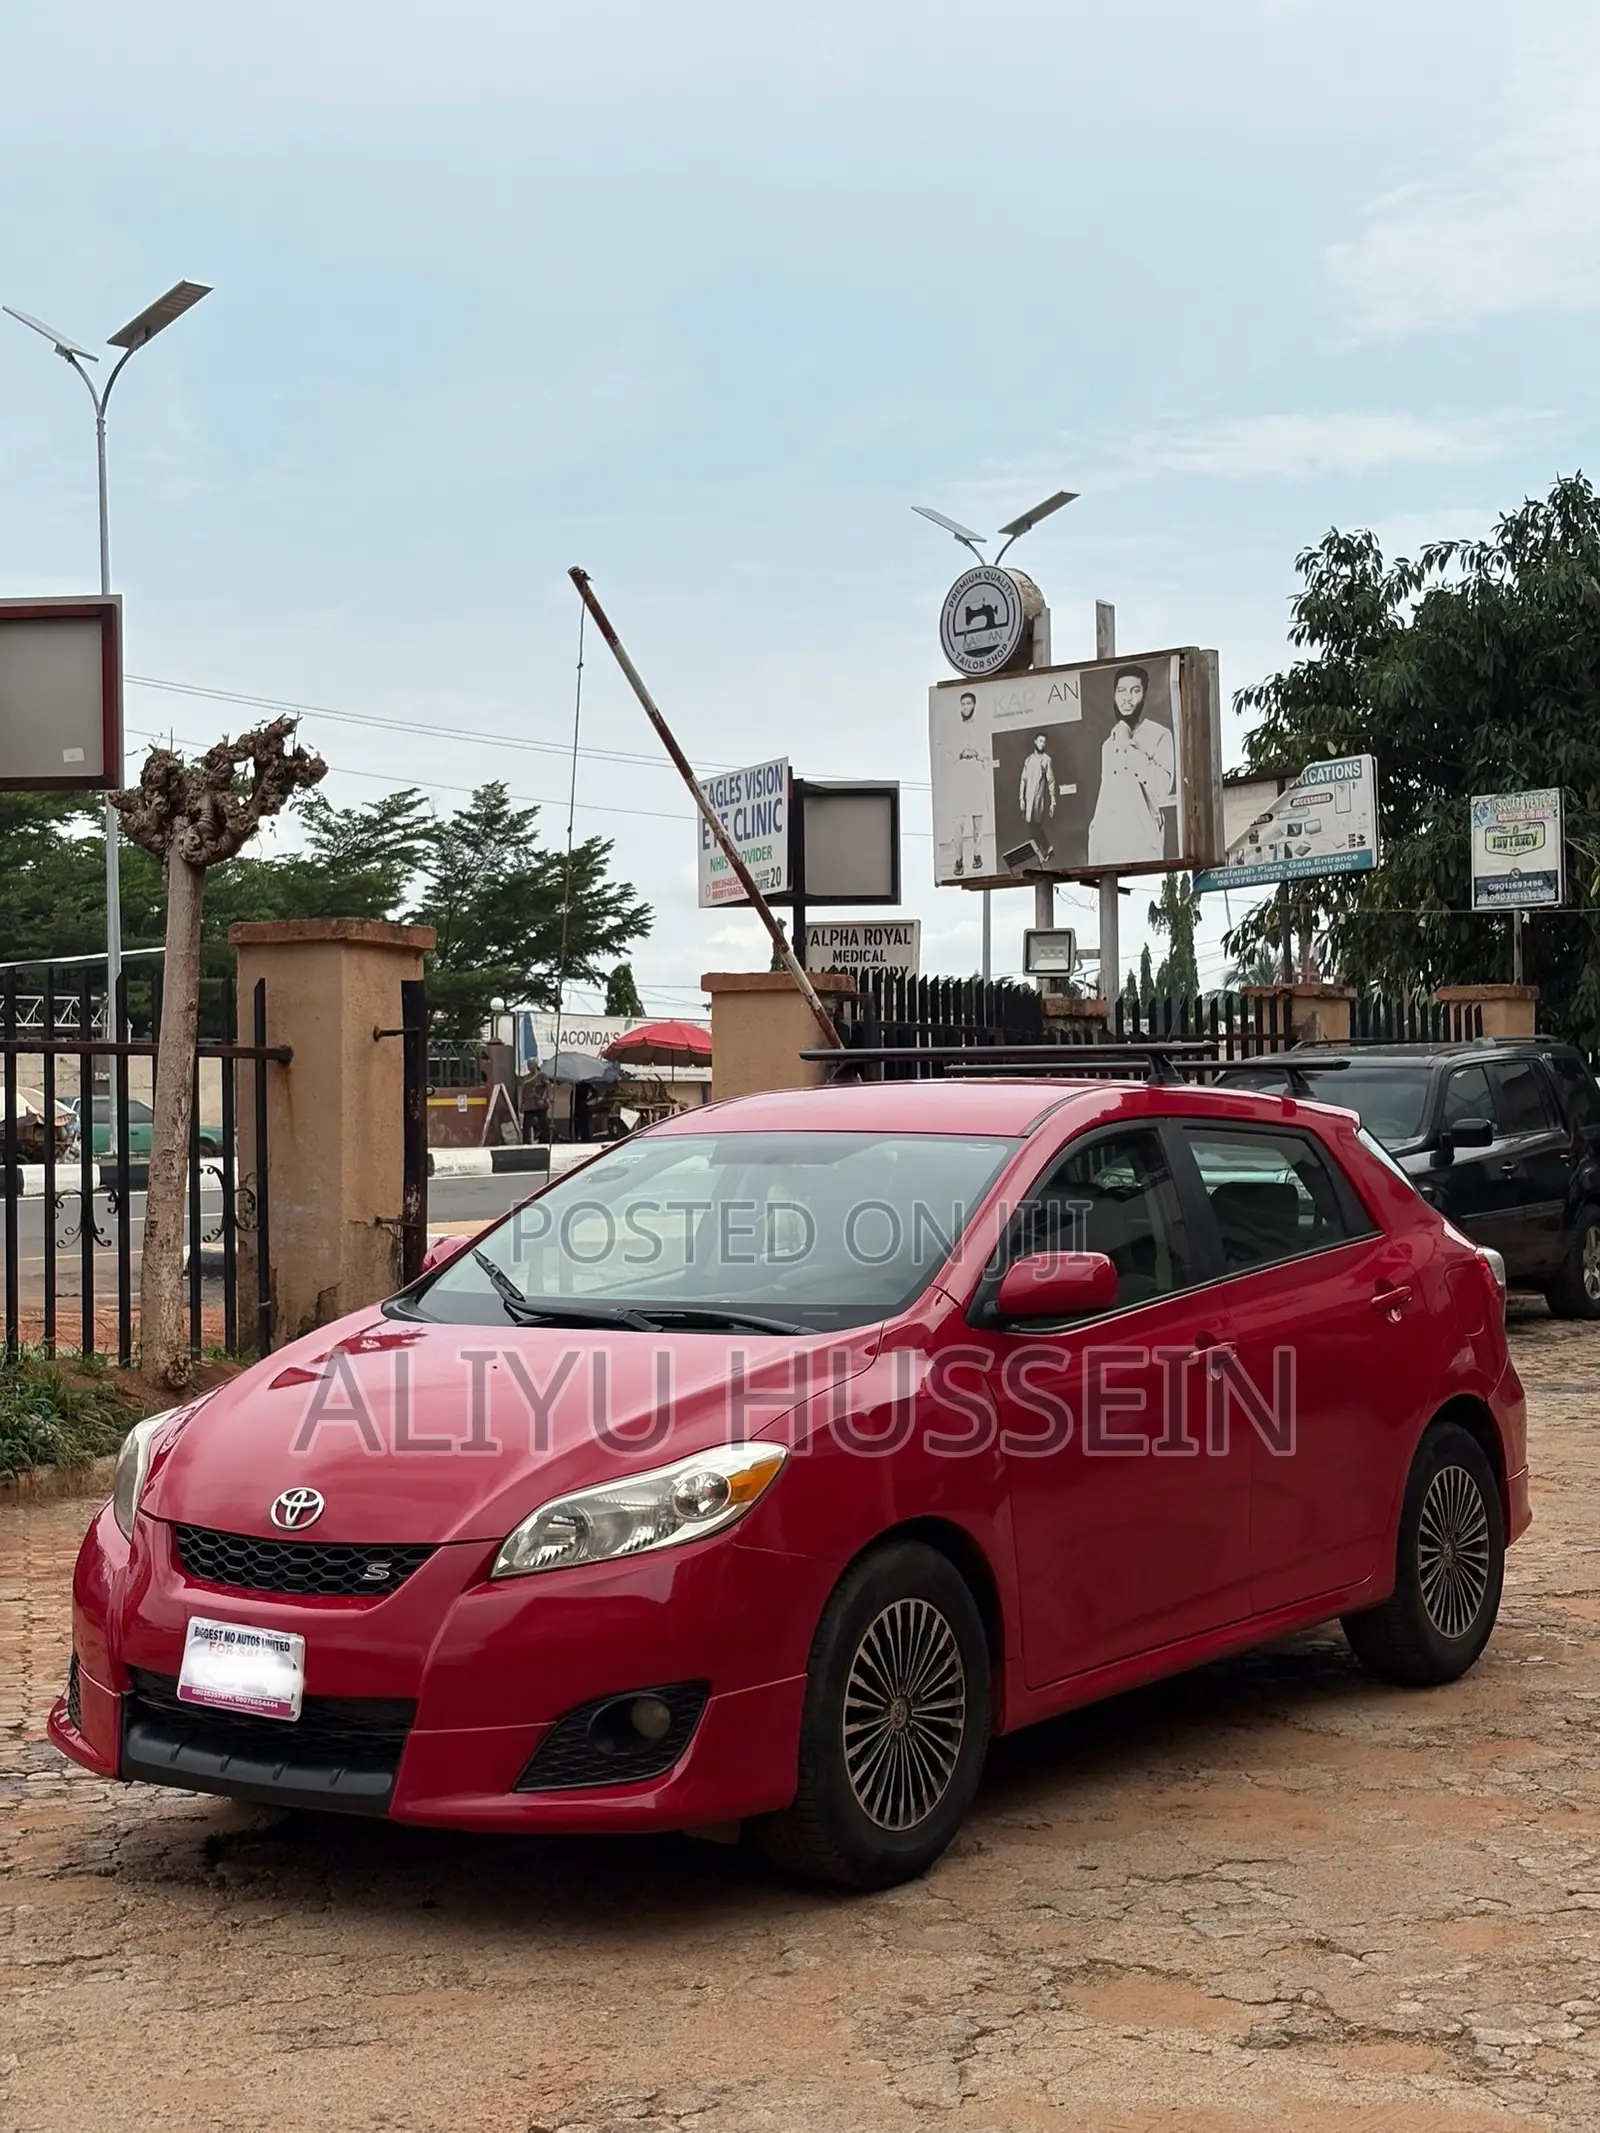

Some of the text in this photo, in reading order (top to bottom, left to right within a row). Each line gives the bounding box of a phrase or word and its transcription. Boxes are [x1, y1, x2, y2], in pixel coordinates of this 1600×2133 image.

[948, 570, 1015, 609] PREMIUM QUALITY
[954, 643, 1009, 670] TAILOR SHOP
[744, 763, 783, 801] VISION
[733, 797, 783, 843] CLINIC
[1288, 858, 1312, 870] Gate
[1314, 853, 1359, 865] Entrance
[770, 866, 782, 888] 20
[810, 927, 912, 947] ALPHA ROYAL
[832, 949, 887, 964] MEDICAL
[194, 1626, 223, 1641] BIGGEST
[223, 1631, 236, 1644] MO
[236, 1633, 260, 1648] AUTOS
[208, 1641, 234, 1655] FOR
